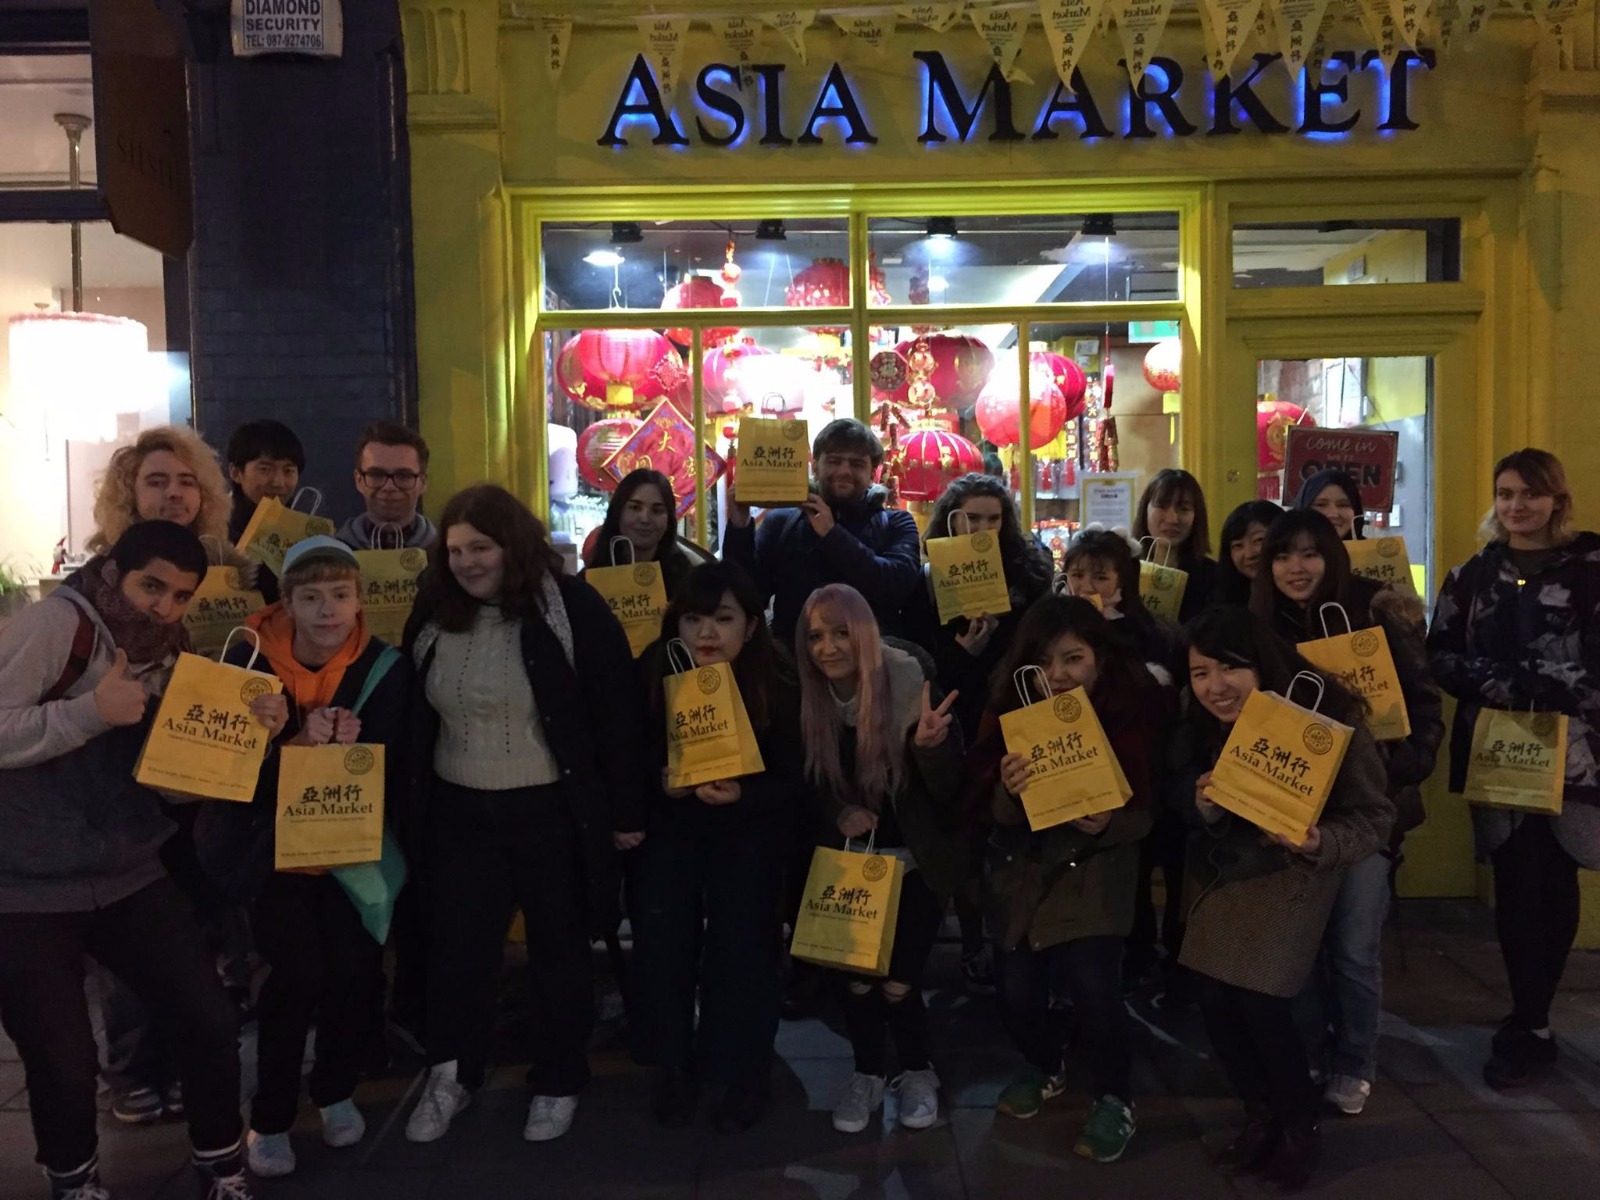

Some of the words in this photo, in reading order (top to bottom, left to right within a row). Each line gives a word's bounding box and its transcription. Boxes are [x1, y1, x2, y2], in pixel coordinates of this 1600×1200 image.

[245, 0, 321, 15] DIAMOND
[246, 18, 320, 31] SECURITY
[246, 34, 265, 47] TEL:
[597, 53, 878, 146] ASIA
[913, 50, 1436, 143] MARKET
[753, 446, 796, 460] 亞洲行
[742, 459, 762, 467] Asia
[766, 459, 802, 468] Market
[948, 559, 989, 578] 亞洲行
[939, 579, 960, 588] Asia
[963, 572, 998, 583] Market
[361, 594, 380, 606] sia
[622, 607, 661, 618] Market
[1361, 680, 1390, 693] rket
[183, 704, 250, 735] 亞洲行
[675, 704, 716, 730] 亞洲行
[162, 717, 197, 736] Asia
[202, 726, 258, 750] Market
[669, 729, 689, 742] Asia
[690, 720, 729, 737] Market
[1031, 731, 1083, 764] 亞洲行
[1489, 740, 1543, 757] 亞洲行
[1028, 763, 1048, 776] sia
[1050, 746, 1099, 770] Market
[1250, 737, 1311, 779] 亞洲行
[1504, 754, 1550, 767] Market
[1229, 745, 1260, 767] Asia
[1262, 761, 1315, 796] Market
[301, 784, 363, 805] 亞洲行
[283, 805, 316, 817] Asia
[320, 802, 374, 815] Market
[819, 885, 872, 906] 亞洲行
[806, 900, 830, 911] Asia
[833, 903, 878, 920] Market
